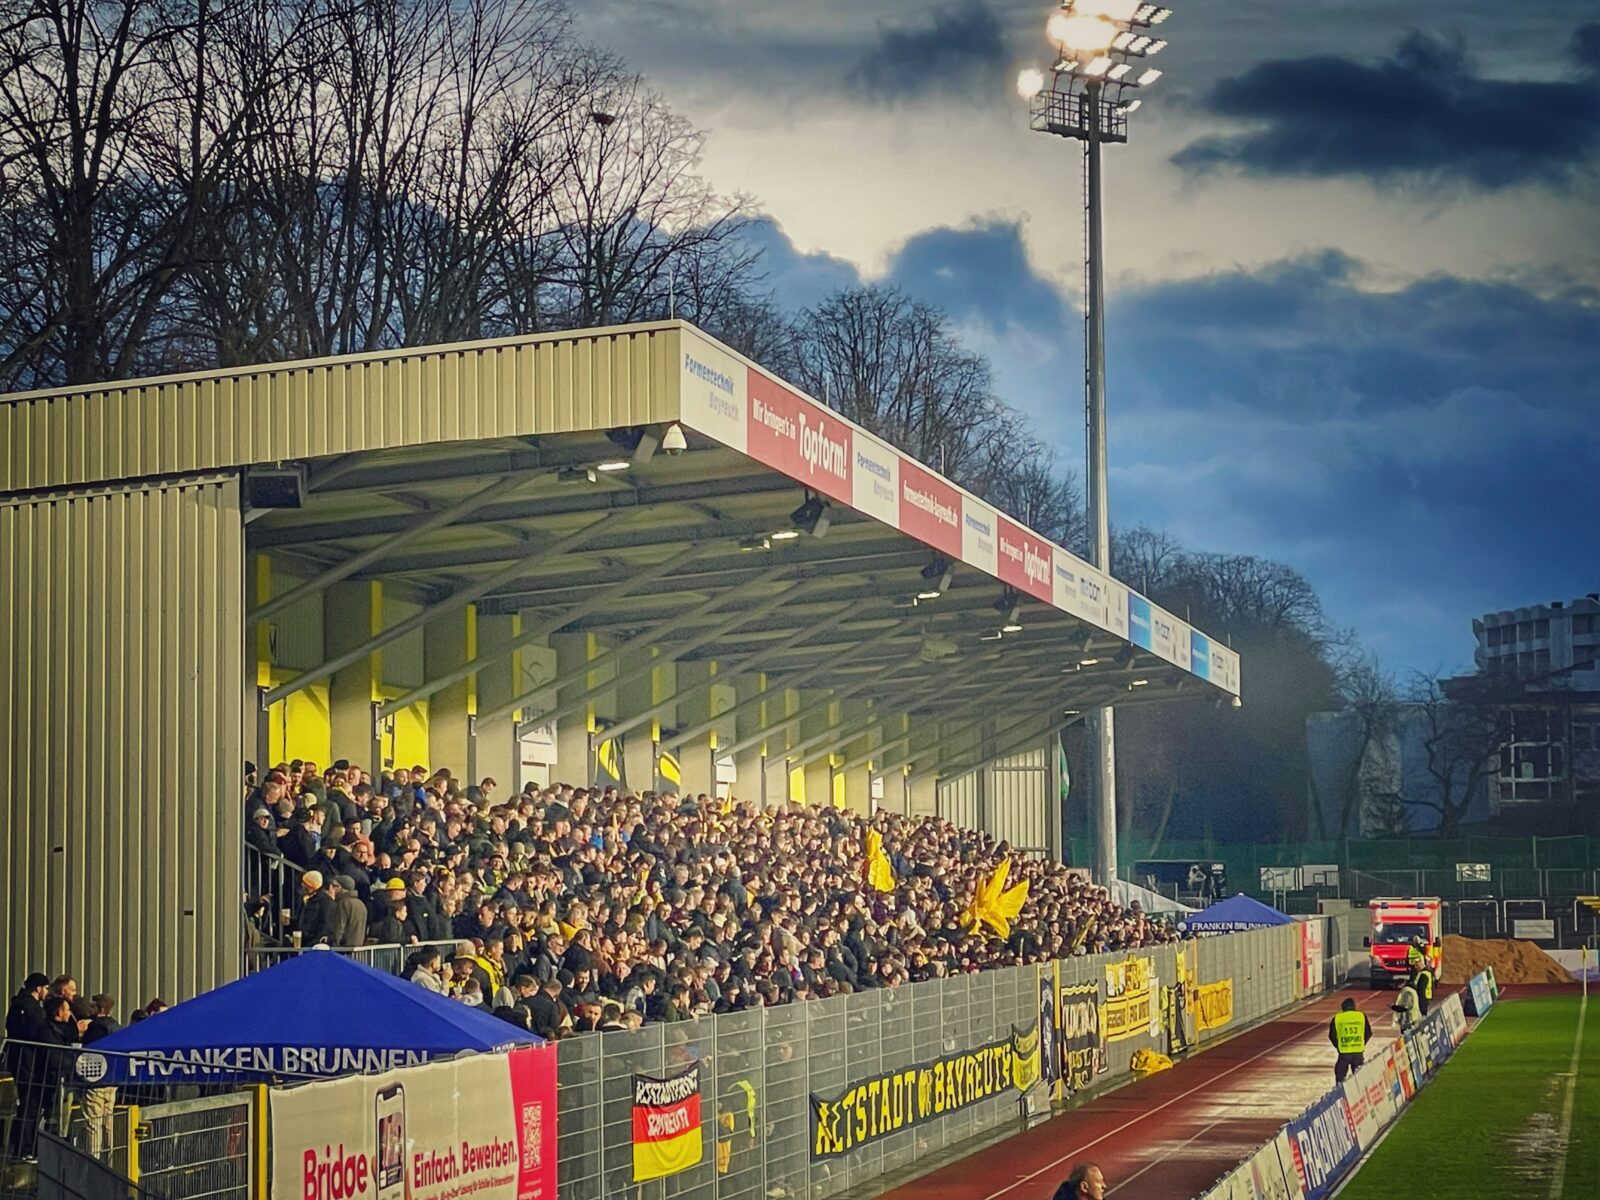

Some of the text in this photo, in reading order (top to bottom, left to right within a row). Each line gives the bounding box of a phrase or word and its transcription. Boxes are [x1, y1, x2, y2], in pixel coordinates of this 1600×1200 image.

[684, 353, 734, 395] Formentechnik
[799, 412, 848, 480] Topform!
[1192, 922, 1233, 931] FRANKEN
[129, 1047, 428, 1077] FRANKEN BRUNNEN
[815, 1070, 916, 1156] ALTSTADT
[934, 1043, 1011, 1114] BAYREUTH
[414, 1146, 460, 1189] Einfach.
[462, 1135, 517, 1175] Bewerben.
